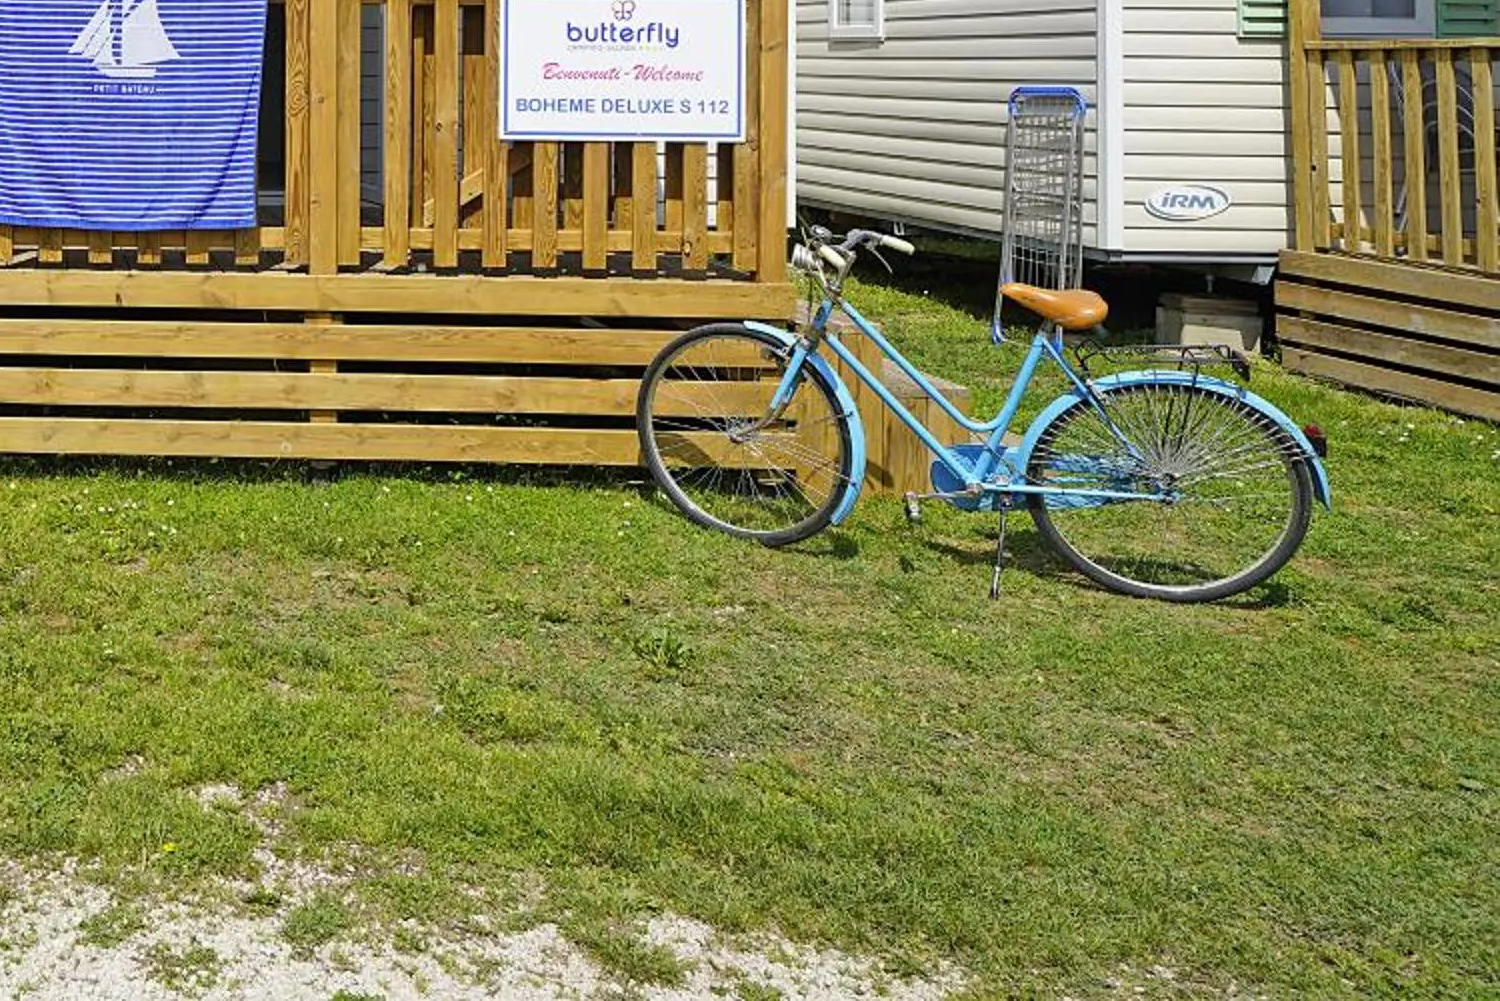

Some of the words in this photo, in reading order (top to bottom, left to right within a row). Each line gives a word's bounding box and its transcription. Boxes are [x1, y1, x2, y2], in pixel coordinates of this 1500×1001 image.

[567, 22, 679, 48] butterfly
[632, 64, 704, 82] Welcome
[515, 98, 595, 113] BOHEME
[601, 98, 674, 114] DELUXE
[679, 99, 691, 114] S
[697, 100, 729, 114] 112
